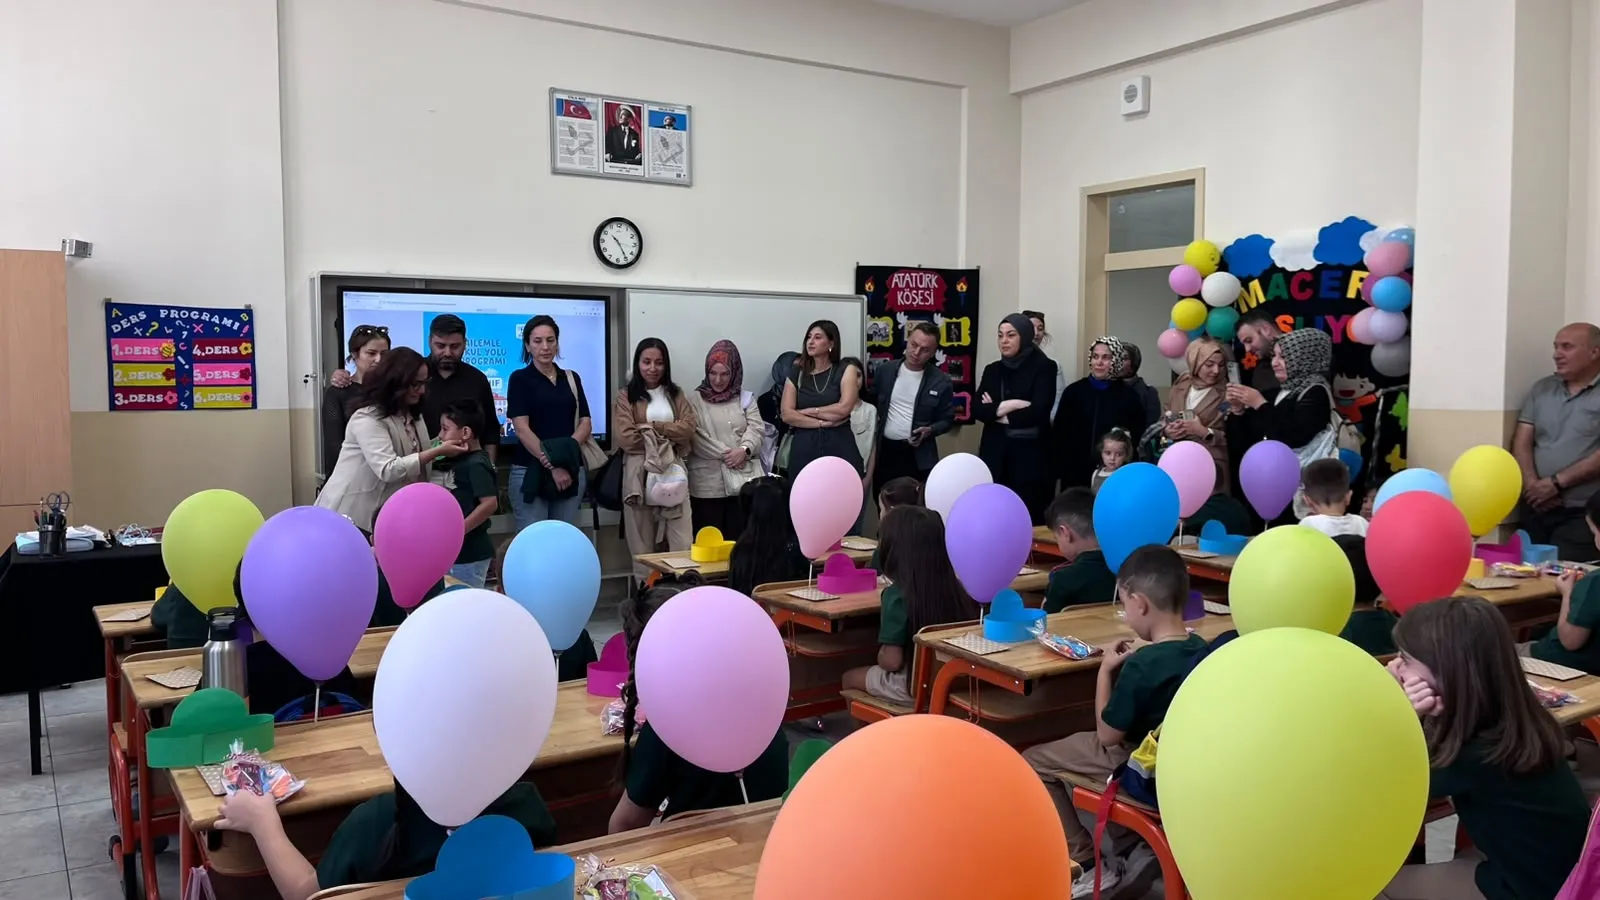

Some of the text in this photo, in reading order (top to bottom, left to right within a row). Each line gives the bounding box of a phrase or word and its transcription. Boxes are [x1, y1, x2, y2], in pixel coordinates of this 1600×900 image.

[891, 272, 938, 289] ATATÜRK
[897, 289, 935, 307] KÖŞESİ
[1238, 270, 1369, 314] MACER
[111, 309, 240, 333] DERS PROGRAMI
[465, 348, 507, 356] KUL YOLU
